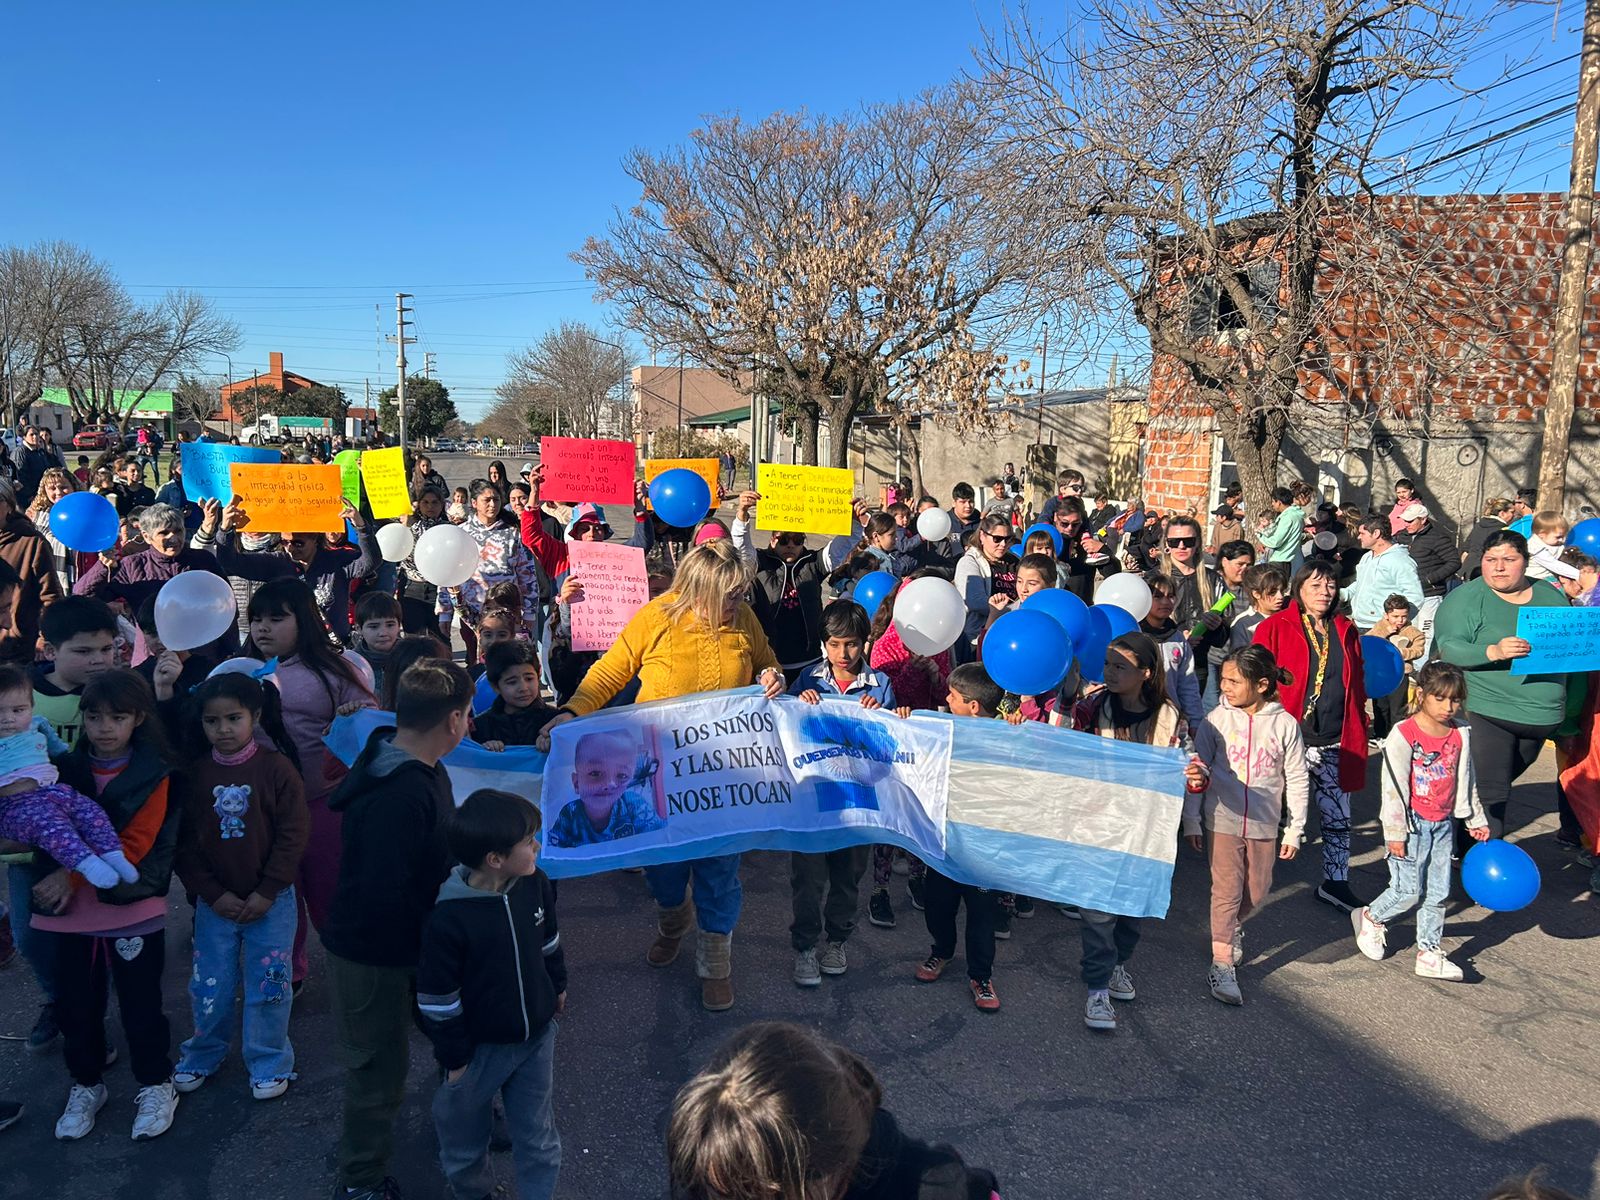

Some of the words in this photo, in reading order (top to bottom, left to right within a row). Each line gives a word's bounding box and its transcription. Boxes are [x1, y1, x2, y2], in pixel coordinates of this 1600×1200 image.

[192, 450, 225, 462] BASTA
[232, 454, 248, 462] DE
[672, 724, 709, 749] LOS
[715, 710, 774, 737] NIÑOS
[670, 757, 682, 778] Y
[688, 750, 724, 774] LAS
[728, 741, 782, 769] NIÑAS
[1228, 745, 1246, 762] Be
[726, 781, 791, 808] TOCAN
